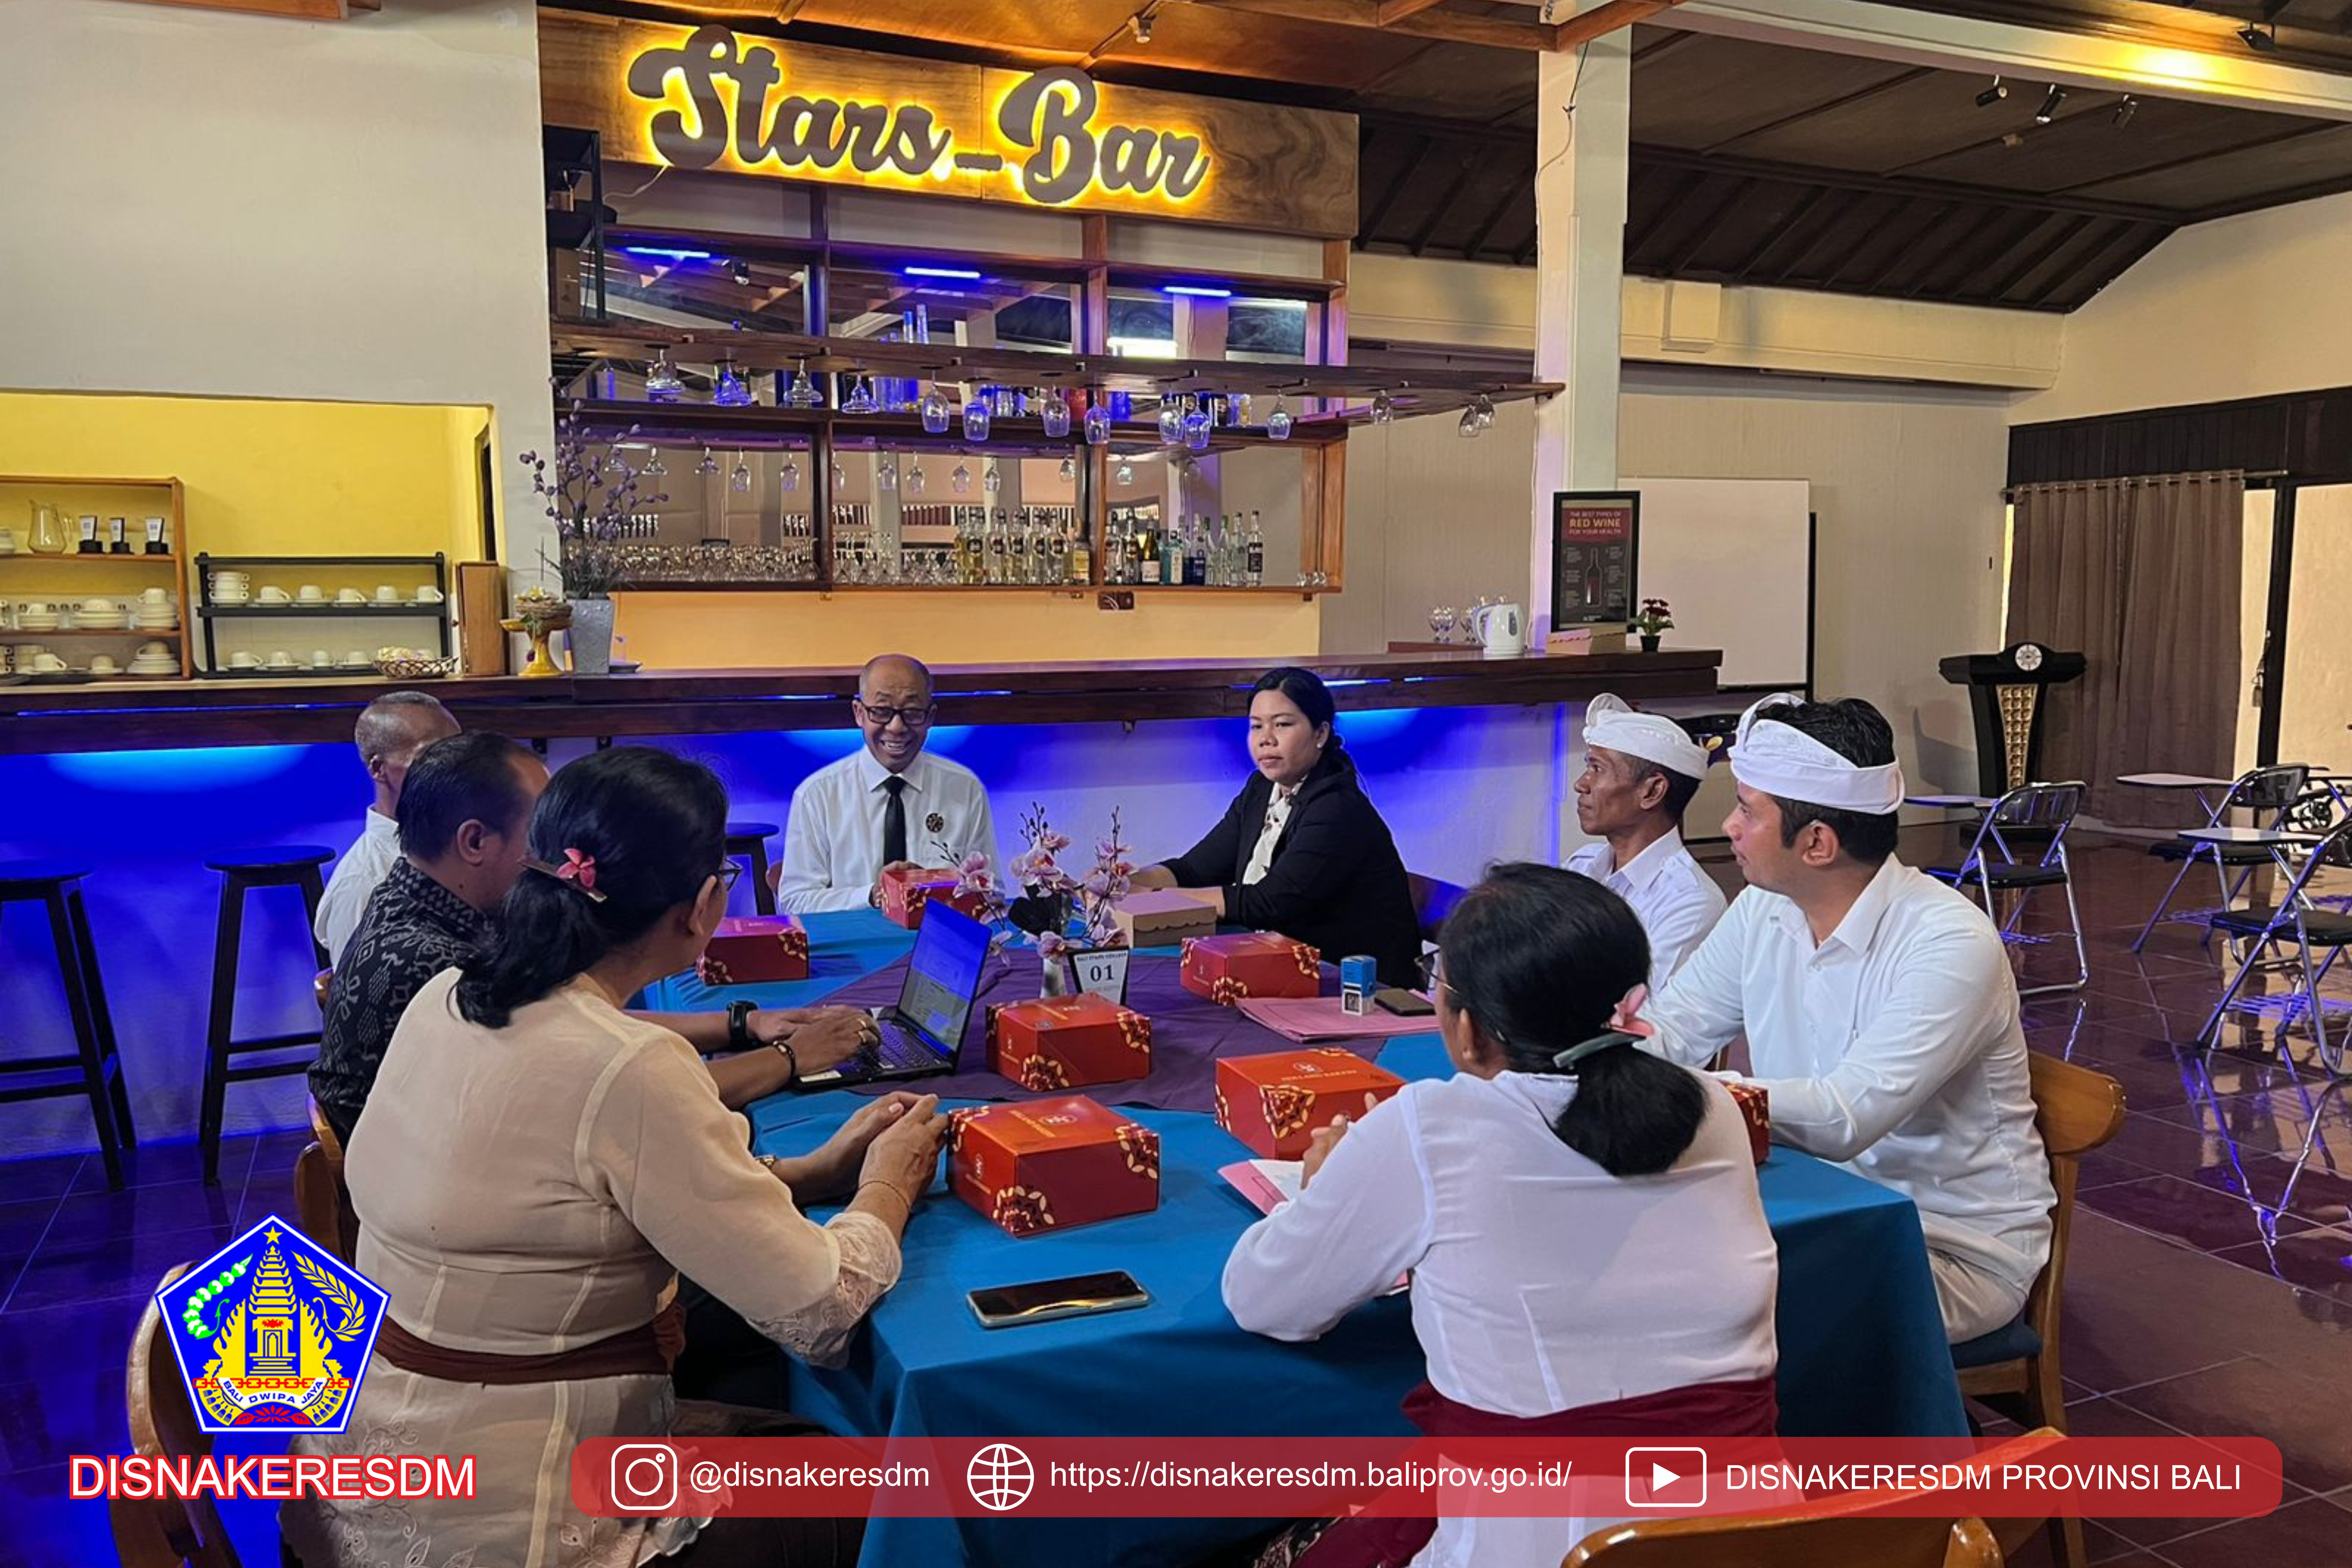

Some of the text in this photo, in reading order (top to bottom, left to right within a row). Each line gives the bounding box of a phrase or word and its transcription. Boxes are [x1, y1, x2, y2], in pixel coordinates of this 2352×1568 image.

[628, 24, 951, 175] Stars
[998, 66, 1210, 204] Bar
[1570, 518, 1621, 528] RED WINE
[1090, 964, 1114, 982] 01
